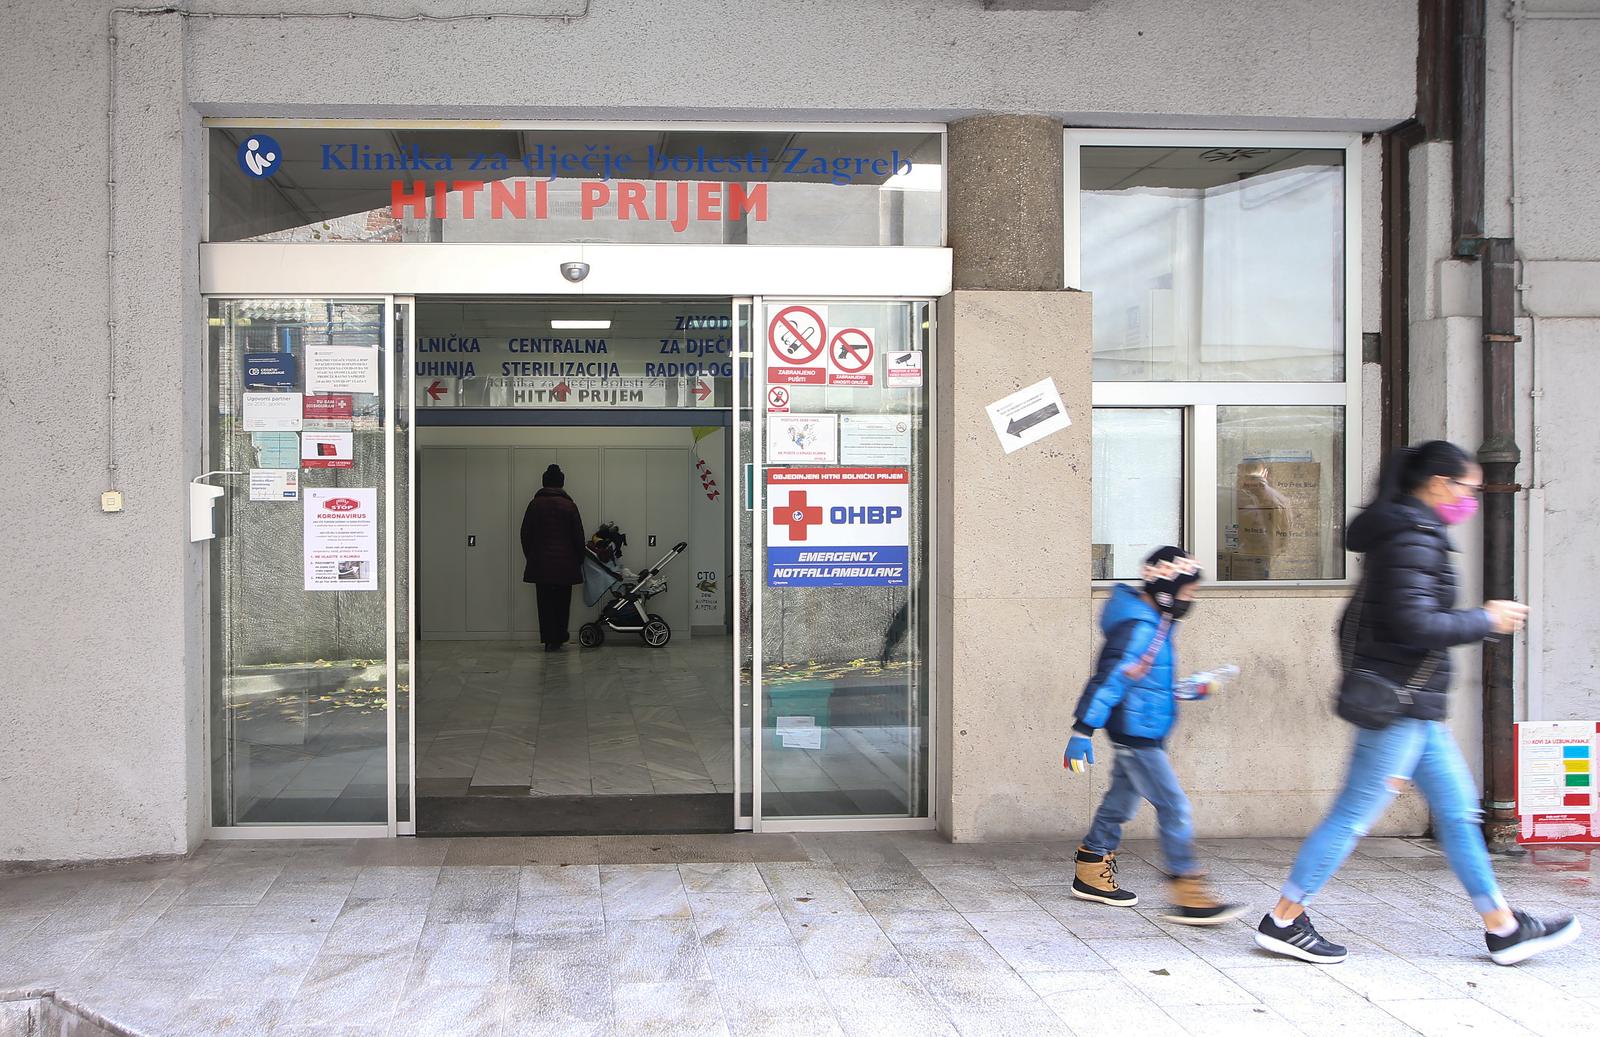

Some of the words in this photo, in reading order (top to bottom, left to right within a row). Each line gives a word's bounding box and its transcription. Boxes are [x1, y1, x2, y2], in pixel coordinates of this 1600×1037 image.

[321, 143, 454, 172] Klinika
[468, 151, 508, 172] za
[523, 143, 632, 182] dječje
[647, 144, 769, 174] bolesti
[783, 148, 913, 186] Zagreb
[391, 180, 548, 220] HITNI
[581, 182, 768, 232] PRIJEM
[675, 316, 730, 331] ZAVOD
[508, 338, 608, 354] CENTRALNA
[660, 339, 681, 354] ZA
[416, 362, 476, 380] UHINJA
[502, 362, 620, 379] STERILIZACIJA
[578, 390, 644, 405] PRIJEM
[830, 506, 902, 524] OHBP
[798, 552, 878, 562] EMERGENCY
[773, 568, 903, 578] NOTFALLAMBULANZ
